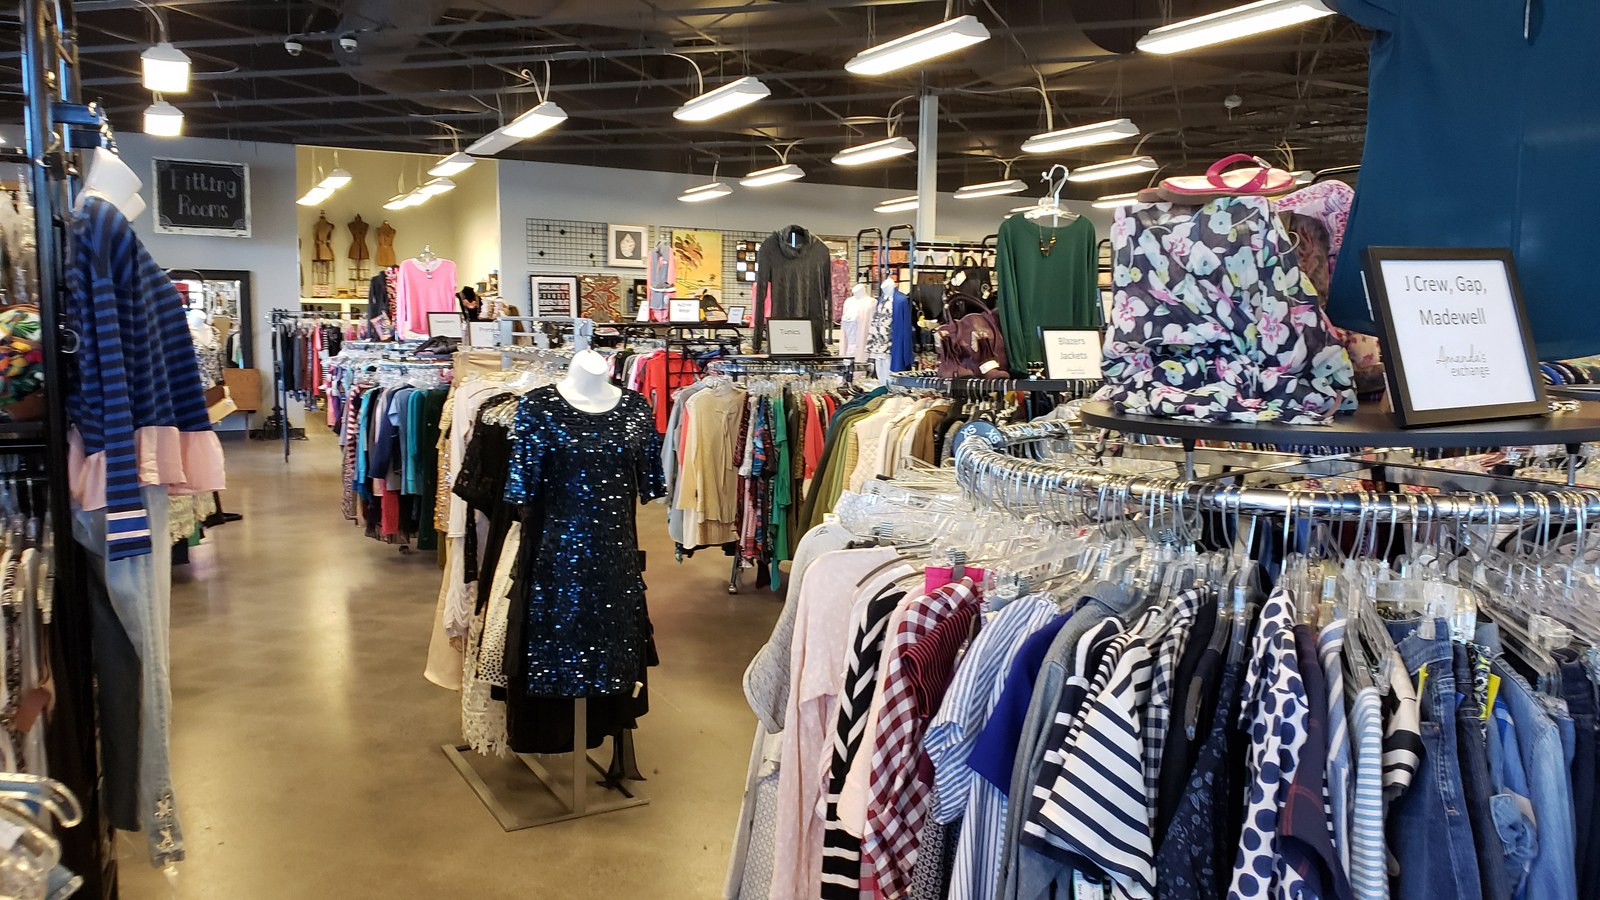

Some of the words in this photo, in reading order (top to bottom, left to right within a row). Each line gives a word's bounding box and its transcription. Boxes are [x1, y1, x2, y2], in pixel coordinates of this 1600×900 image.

[178, 193, 229, 219] Rooms
[1405, 275, 1411, 292] J
[1413, 275, 1454, 295] Crew,
[1455, 275, 1488, 296] Gap,
[1418, 307, 1488, 326] Madewell
[1057, 336, 1086, 345] Blazers
[1450, 365, 1491, 378] exchange
[960, 424, 977, 439] XS
